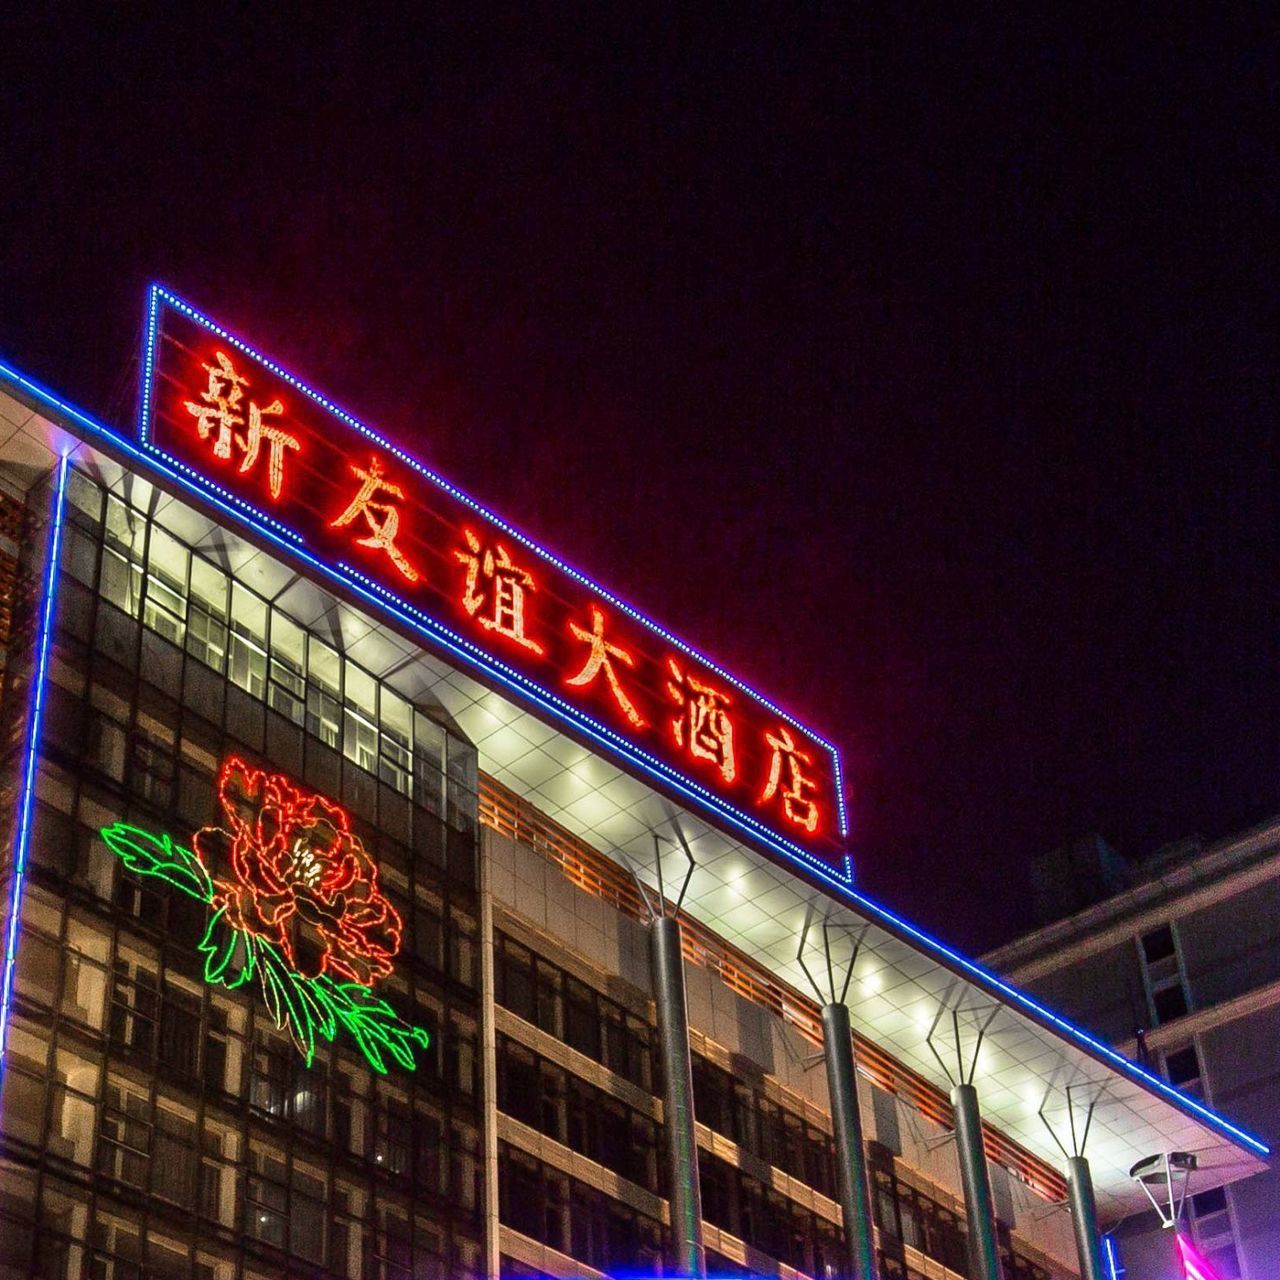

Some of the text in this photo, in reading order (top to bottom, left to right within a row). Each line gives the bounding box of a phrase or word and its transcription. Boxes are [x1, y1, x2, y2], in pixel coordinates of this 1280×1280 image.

[184, 352, 818, 832] 新友谊大酒店
